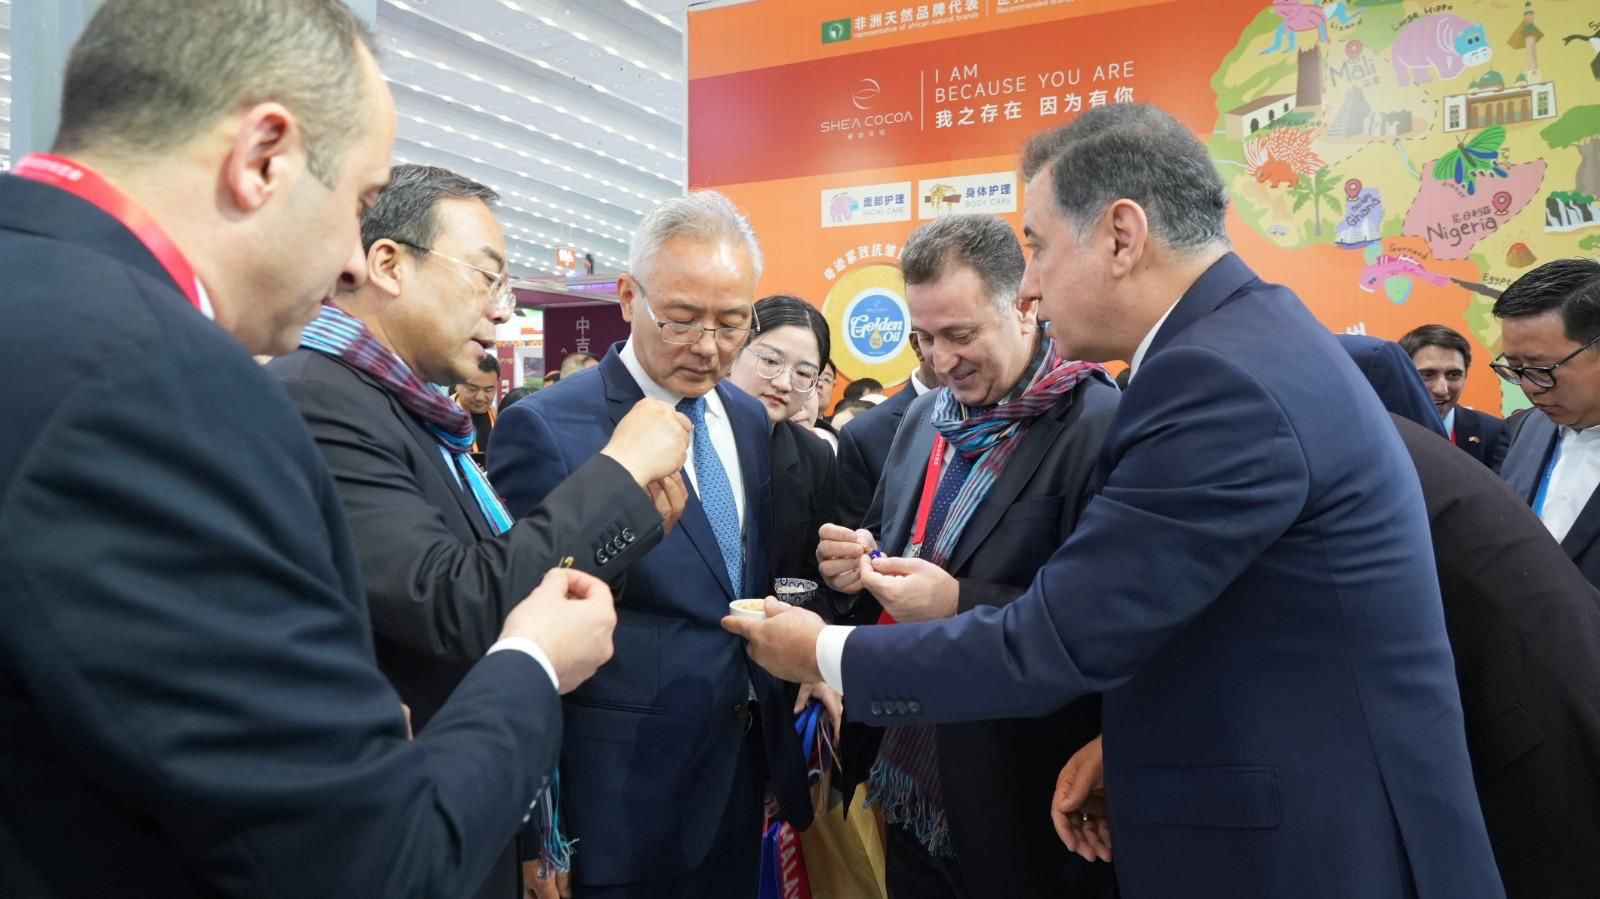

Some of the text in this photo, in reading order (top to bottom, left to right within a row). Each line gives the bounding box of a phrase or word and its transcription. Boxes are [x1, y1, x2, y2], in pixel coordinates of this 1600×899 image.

[855, 0, 978, 31] 非洲天然品牌代表
[935, 64, 978, 84] I AM
[935, 60, 1135, 103] BECAUSE YOU ARE
[1329, 55, 1377, 87] Mali
[935, 86, 1135, 129] 我之存在 因为有你
[820, 111, 914, 133] SHEA COCOA
[863, 193, 905, 208] 面部护理
[965, 183, 1012, 198] 身体护理
[862, 206, 905, 216] FACIAL CARE
[965, 197, 1012, 208] BODY CARE
[1345, 198, 1381, 227] Ghana
[1427, 216, 1498, 247] Nigeria
[850, 314, 903, 339] Golden
[883, 331, 901, 343] Oil
